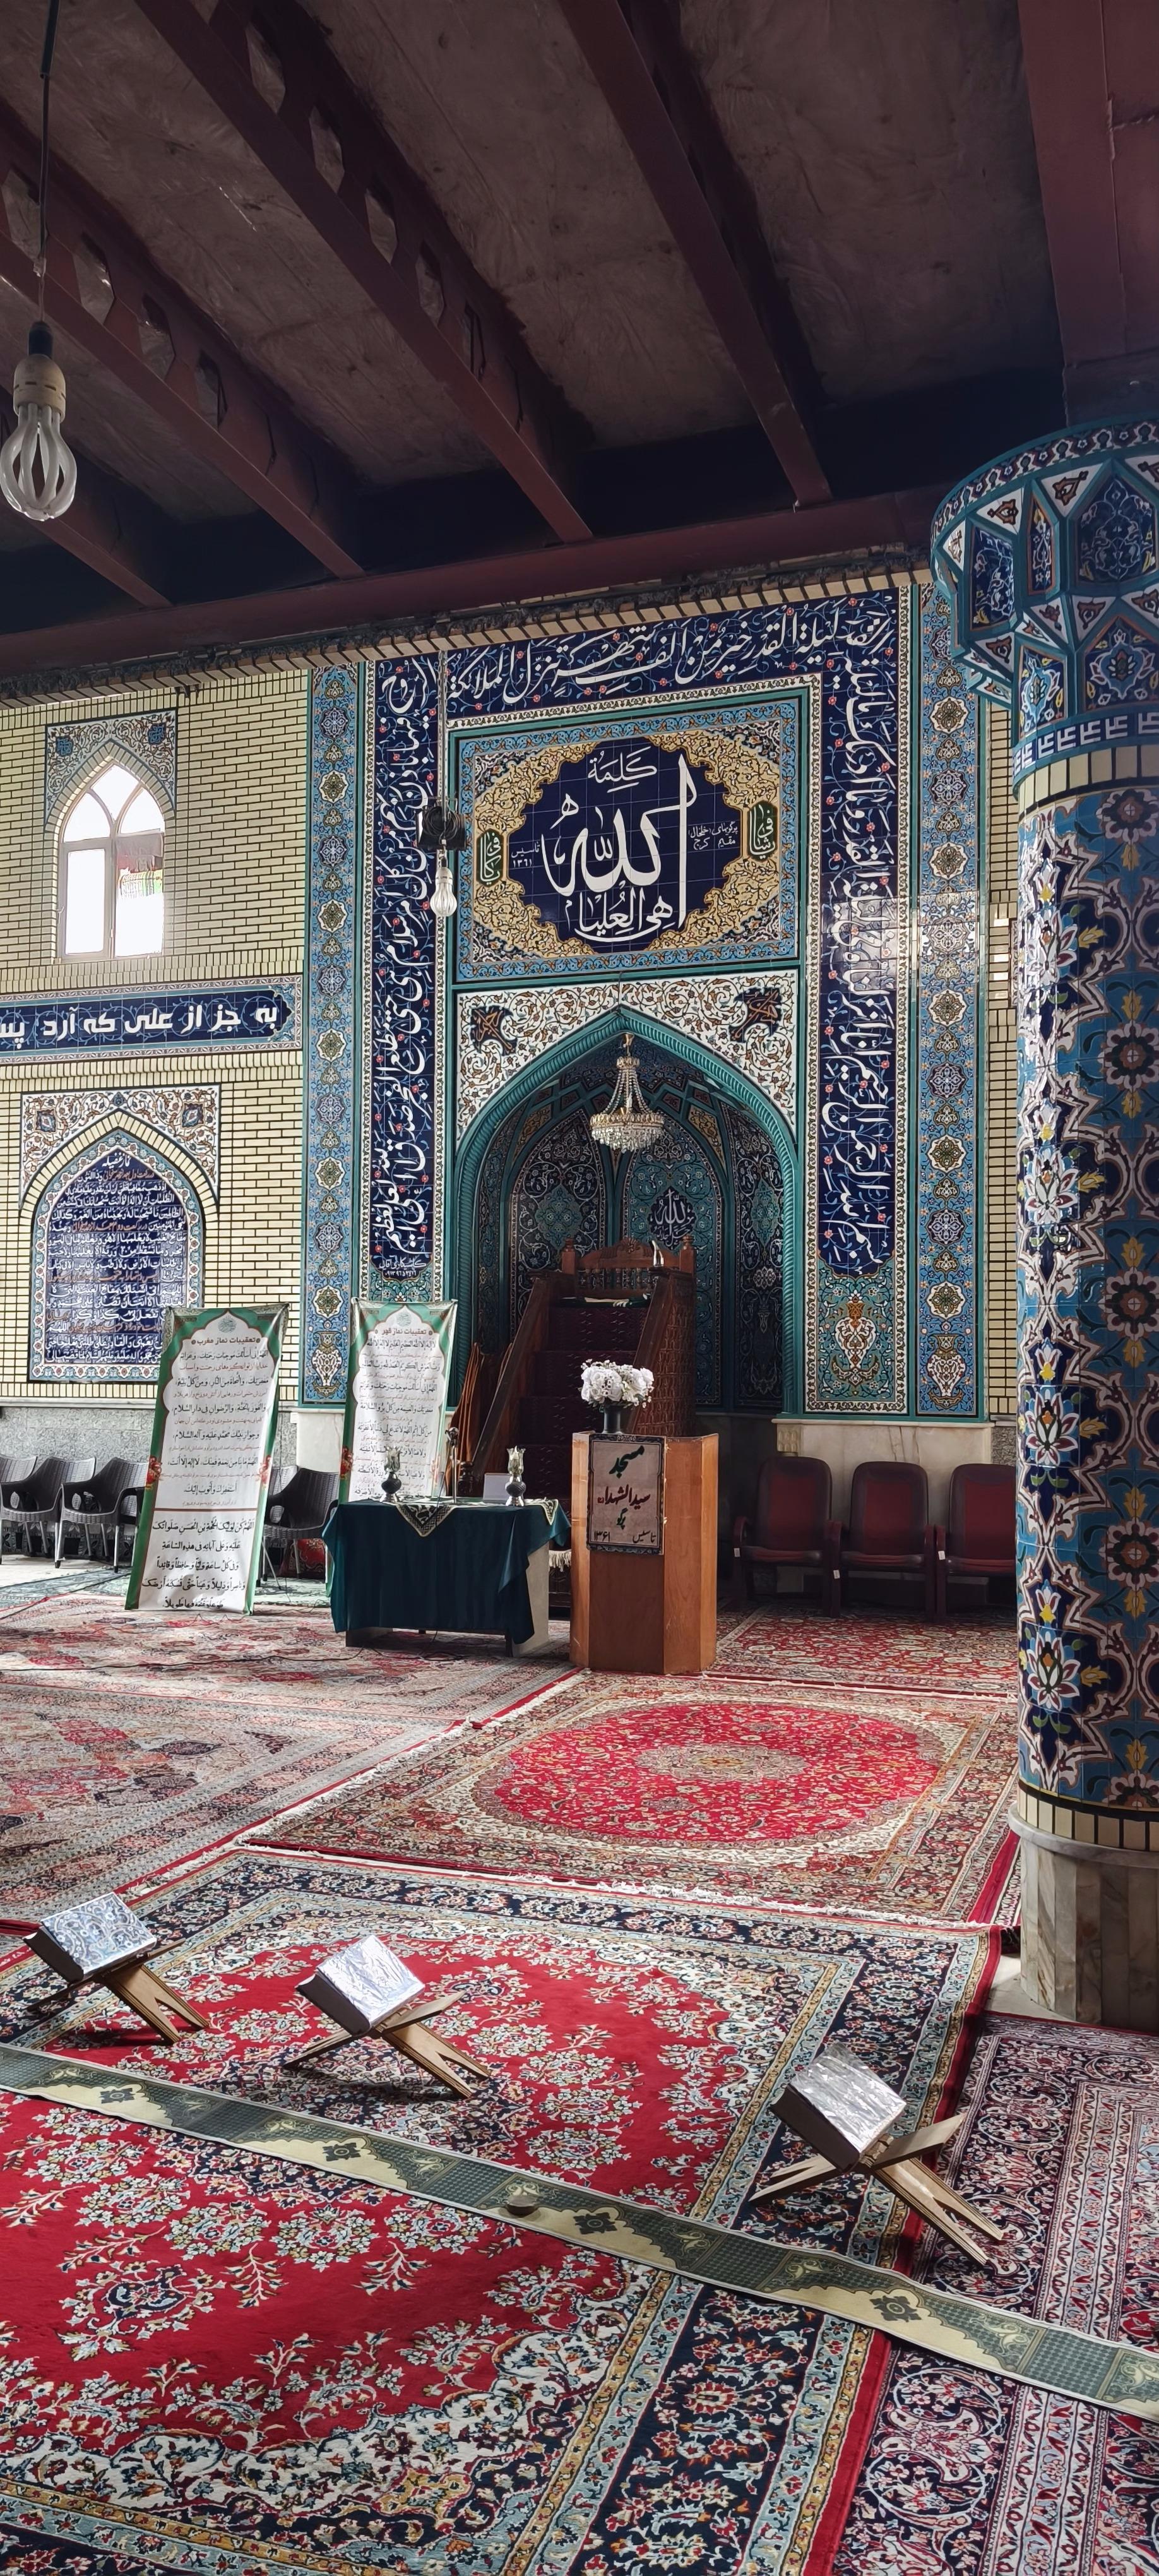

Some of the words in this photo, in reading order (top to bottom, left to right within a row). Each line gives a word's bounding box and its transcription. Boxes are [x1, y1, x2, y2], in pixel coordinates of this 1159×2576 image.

[43, 1006, 76, 1041] آرد
[83, 1011, 116, 1034] که
[124, 1008, 174, 1034] علی
[181, 1005, 203, 1034] از
[211, 1004, 241, 1032] جز
[256, 1008, 278, 1029] به
[609, 1445, 645, 1479] مسجد
[594, 1531, 610, 1542] ۱۳۶۱
